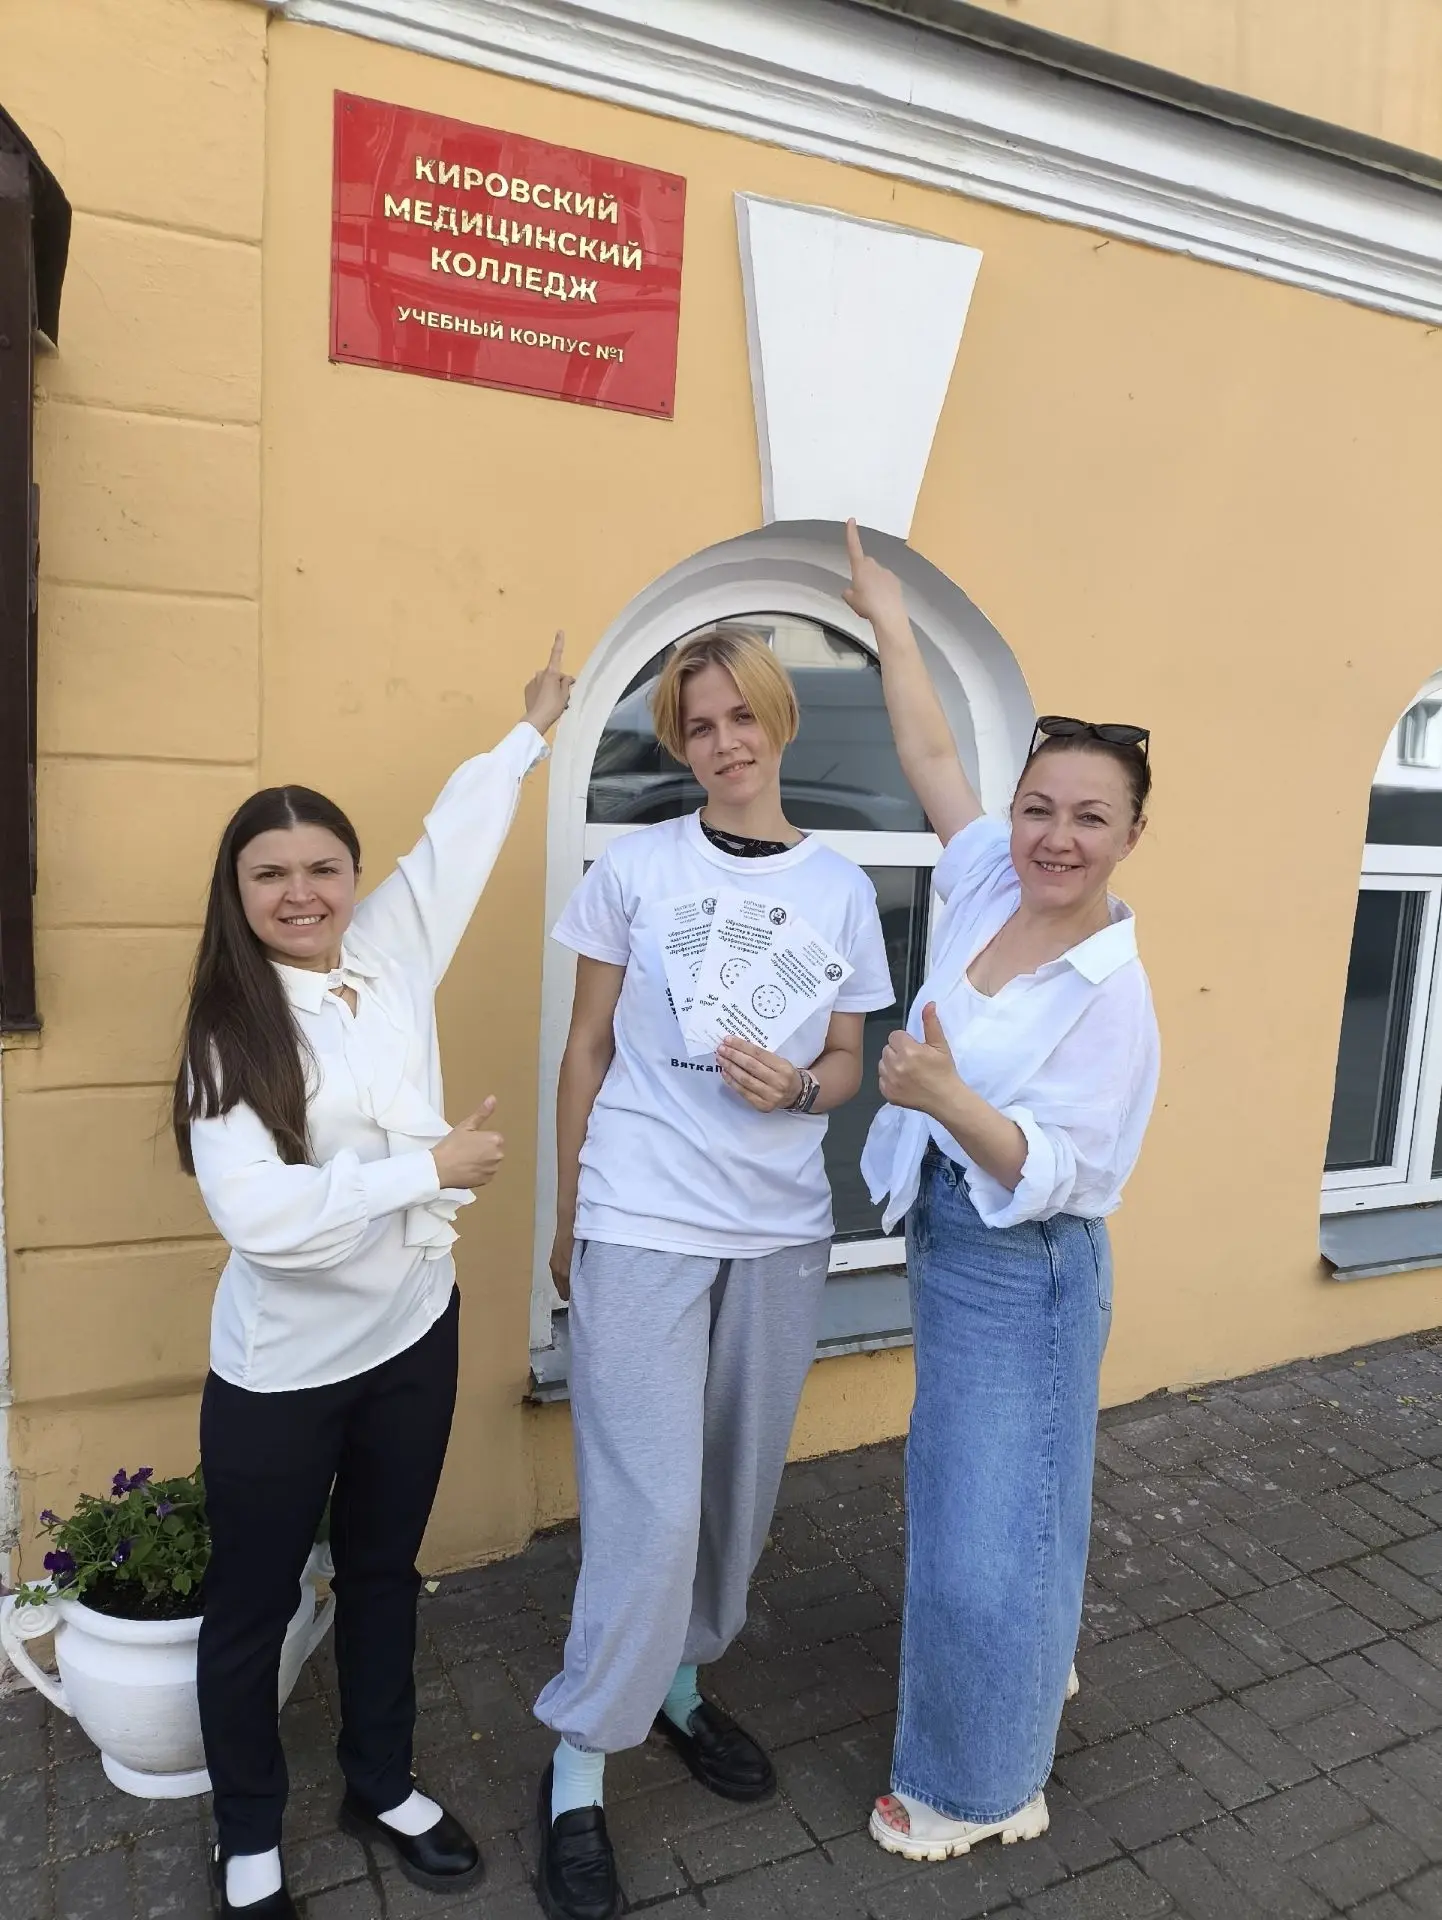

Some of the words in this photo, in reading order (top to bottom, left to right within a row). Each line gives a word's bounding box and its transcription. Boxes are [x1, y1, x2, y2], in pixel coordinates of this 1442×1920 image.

[414, 155, 619, 224] КИРОВСКИЙ
[383, 193, 643, 271] МЕДИЦИНСКИЙ
[430, 246, 599, 303] КОЛЛЕДЖ
[398, 305, 505, 341] УЧЕБНЫЙ
[510, 327, 592, 357] КОРПУС
[596, 344, 624, 363] №1
